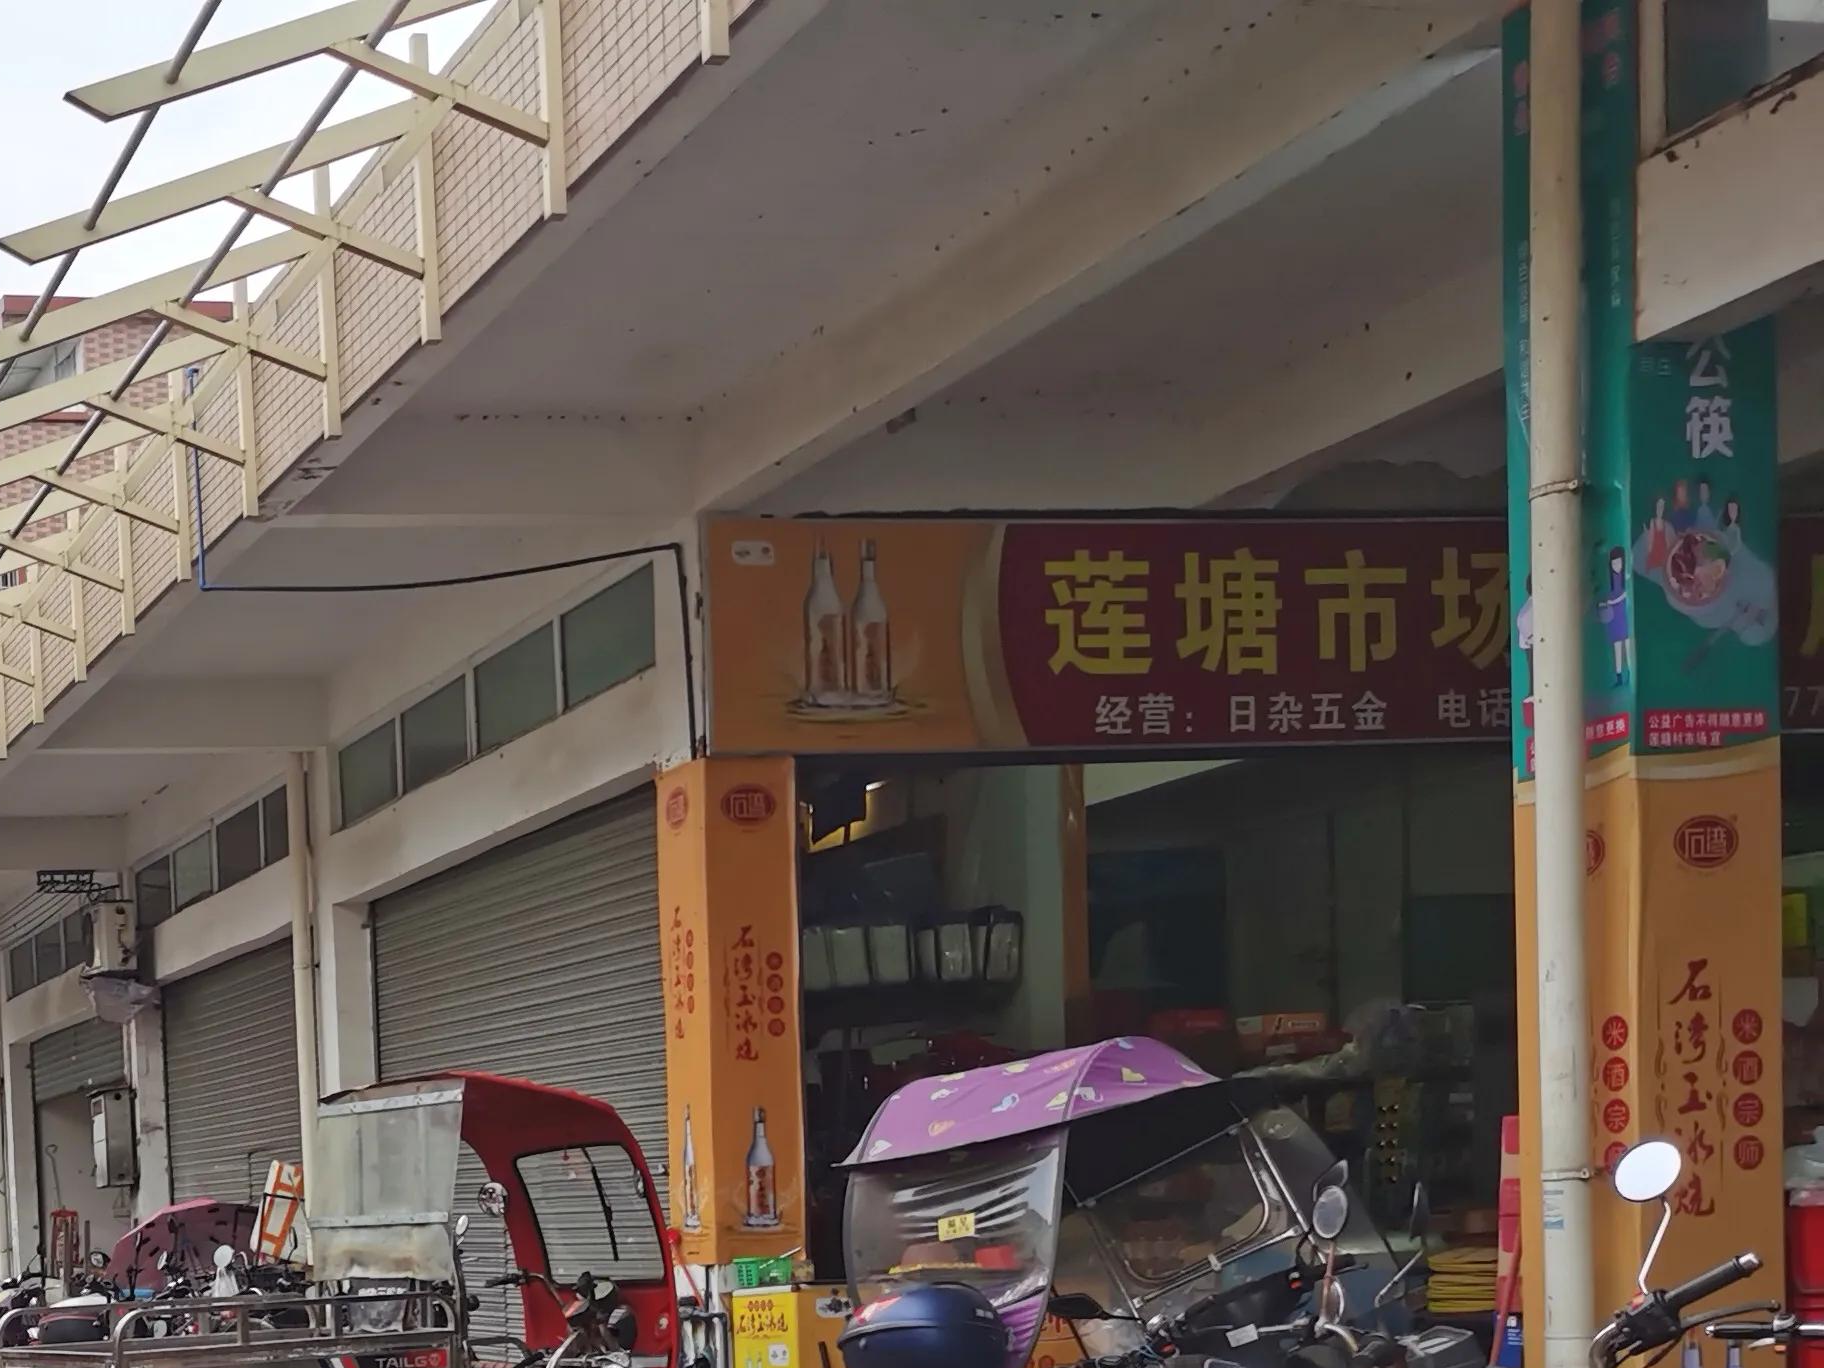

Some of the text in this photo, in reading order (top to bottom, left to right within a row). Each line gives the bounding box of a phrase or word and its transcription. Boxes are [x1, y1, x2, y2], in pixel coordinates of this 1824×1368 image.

[1044, 547, 1511, 678] 莲塘市场
[1228, 690, 1388, 733] 日杂五金
[1438, 687, 1511, 729] 电话
[1735, 1012, 1762, 1168] 米酒宗师
